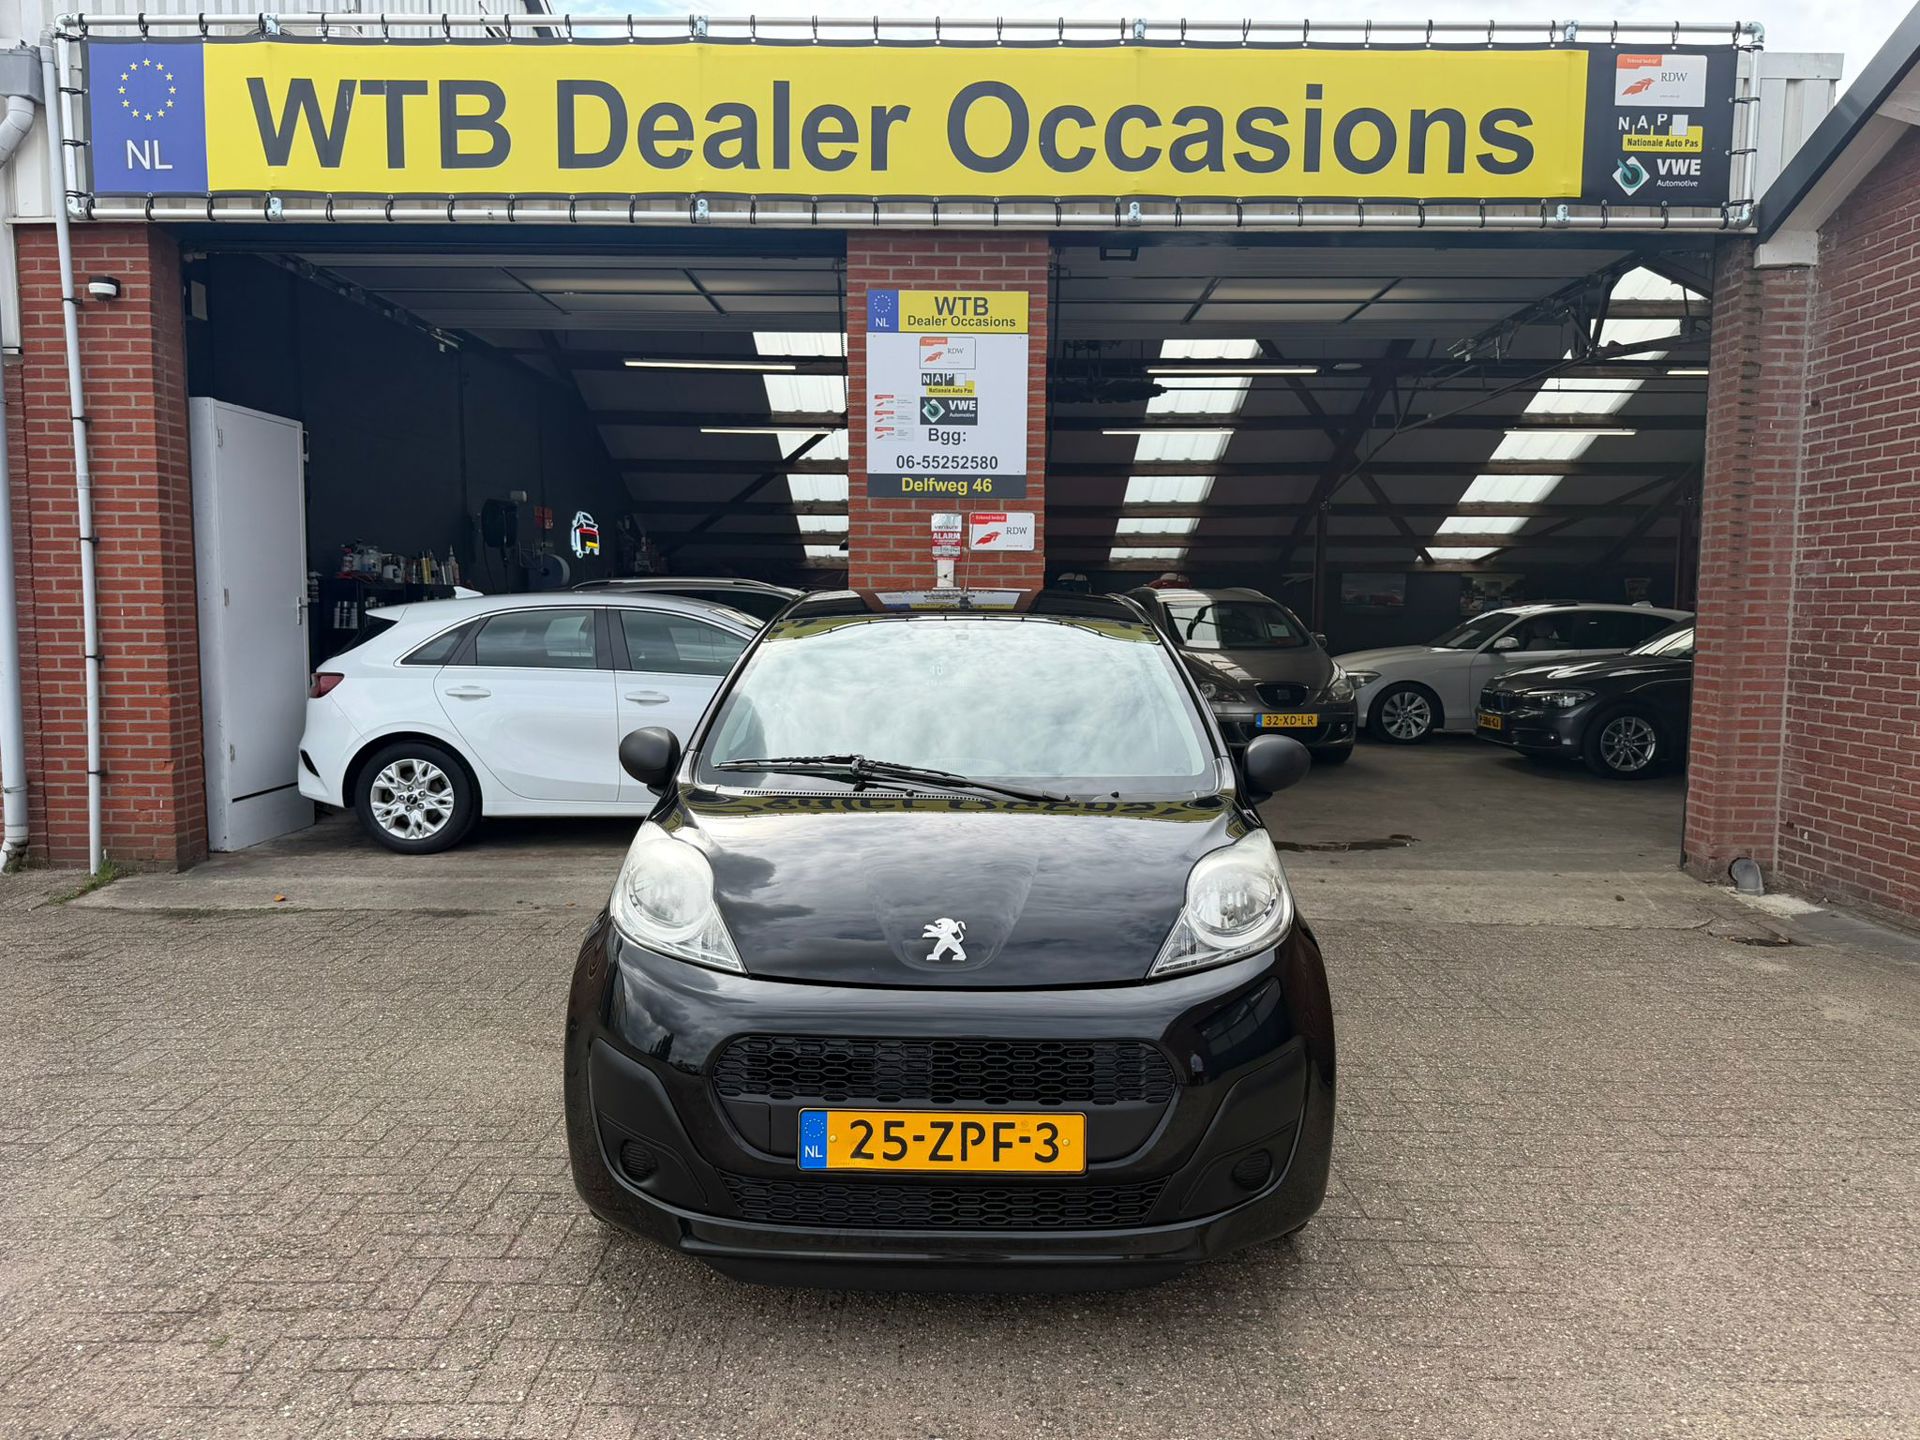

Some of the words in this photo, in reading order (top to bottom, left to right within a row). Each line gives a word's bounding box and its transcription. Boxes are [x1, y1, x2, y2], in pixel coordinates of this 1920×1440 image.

[1660, 72, 1688, 82] RDW
[247, 78, 511, 169] WTB
[557, 80, 911, 172] Dealer
[947, 81, 1534, 175] Occasions
[1627, 138, 1663, 147] Nationale
[1665, 139, 1683, 147] Auto
[1685, 140, 1699, 148] Pas
[126, 140, 173, 170] NL
[1657, 158, 1702, 175] VWE
[1656, 179, 1698, 187] Automotive
[935, 296, 989, 316] WTB
[875, 317, 890, 328] NL
[908, 315, 947, 327] Dealer
[951, 316, 1016, 327] Occasions
[949, 400, 977, 411] VWE
[928, 428, 967, 446] Bgg:
[896, 454, 999, 470] 06-55252580
[901, 477, 968, 496] Delfweg
[972, 478, 993, 493] 46
[932, 532, 961, 540] ALARM
[1006, 526, 1028, 535] RDW
[1266, 715, 1314, 726] 32-XD-LR
[849, 1119, 1060, 1164] 25-ZPF-3
[804, 1145, 824, 1158] NL
